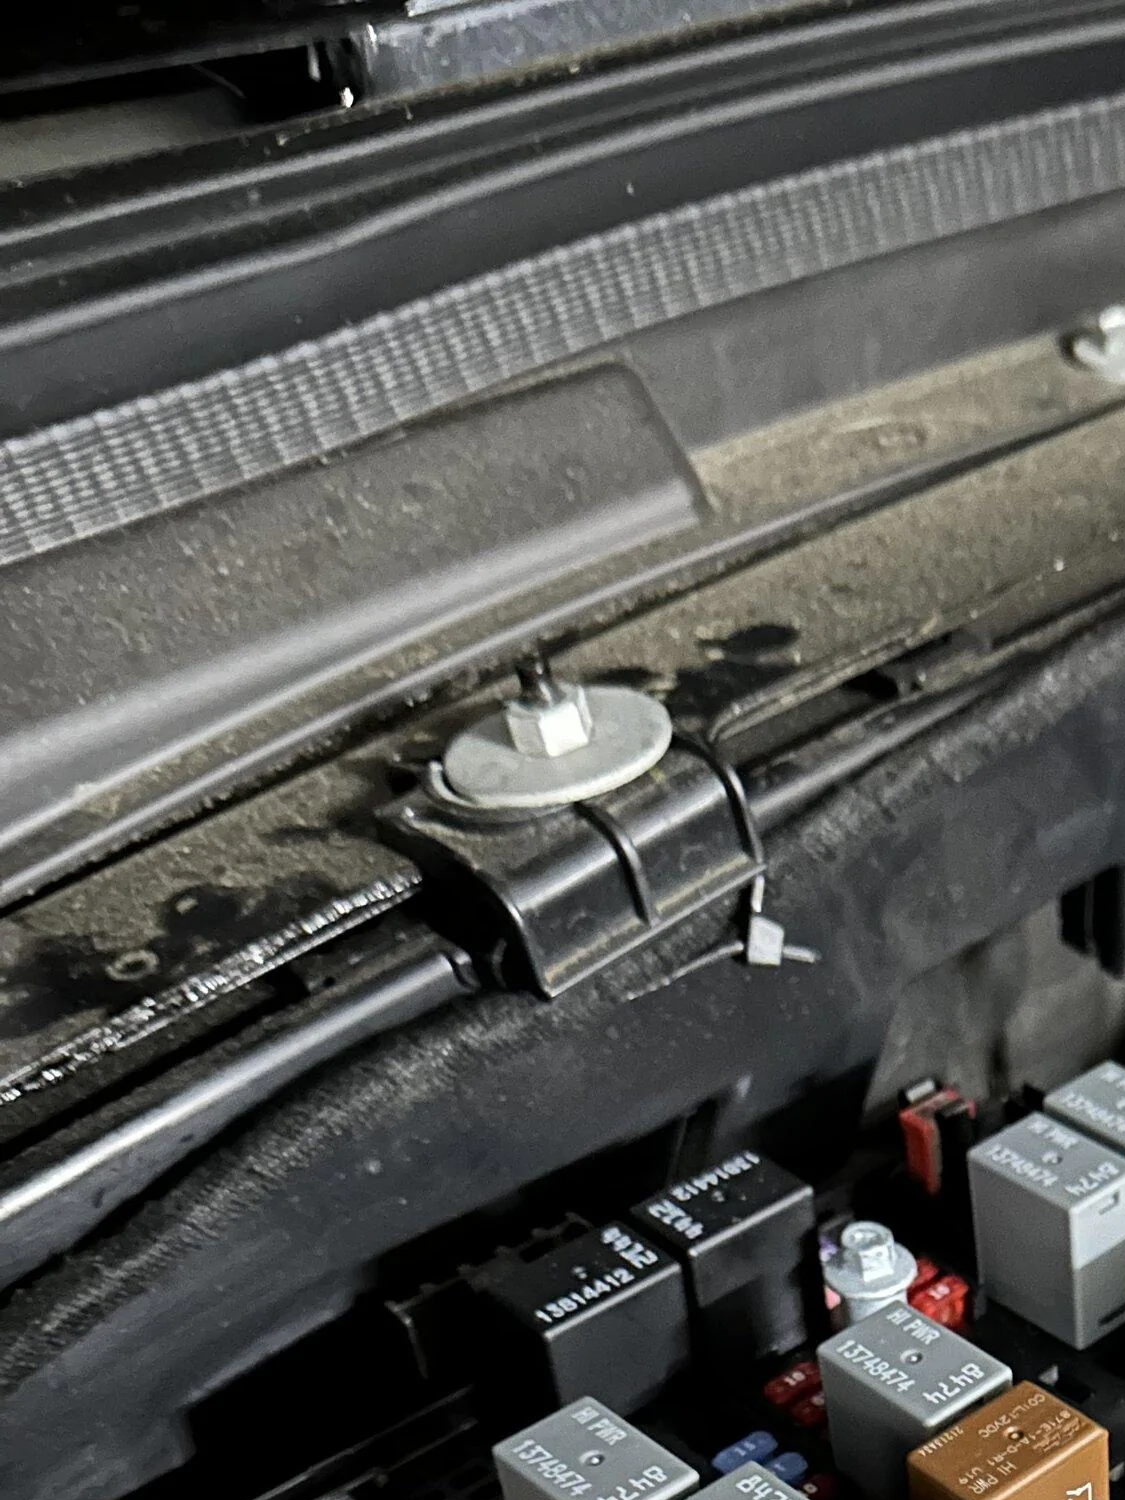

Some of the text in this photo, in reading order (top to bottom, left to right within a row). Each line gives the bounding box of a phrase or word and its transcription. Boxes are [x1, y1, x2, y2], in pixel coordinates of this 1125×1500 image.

[903, 1319, 941, 1345] PWR
[836, 1340, 916, 1392] 13748474
[587, 1418, 627, 1446] PWR
[512, 1439, 593, 1496] 13748474
[968, 1462, 1017, 1494] HI PWR
